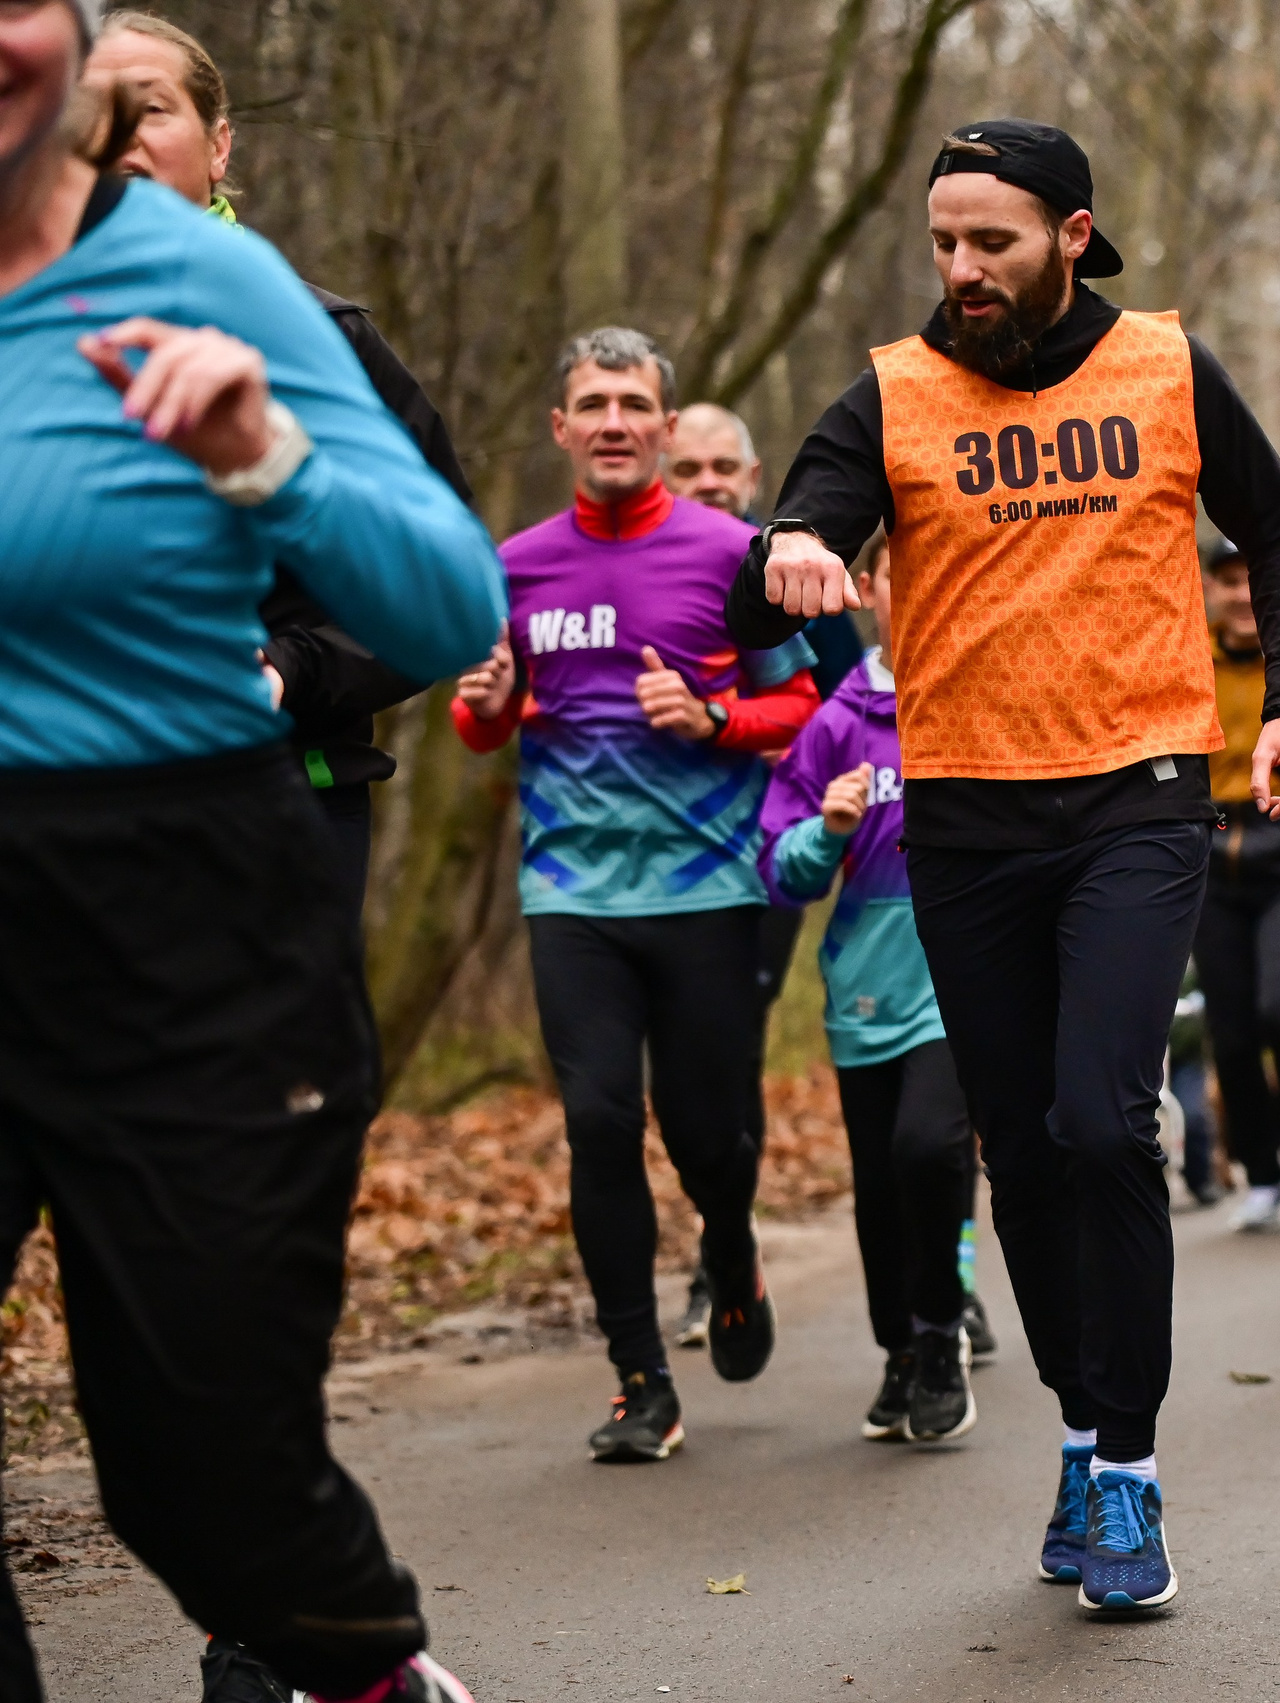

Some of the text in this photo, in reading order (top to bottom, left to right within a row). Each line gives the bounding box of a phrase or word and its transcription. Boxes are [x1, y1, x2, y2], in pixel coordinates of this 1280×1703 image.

[954, 416, 1139, 495] 30:00
[989, 500, 1032, 524] 6:00
[529, 604, 616, 655] W&R
